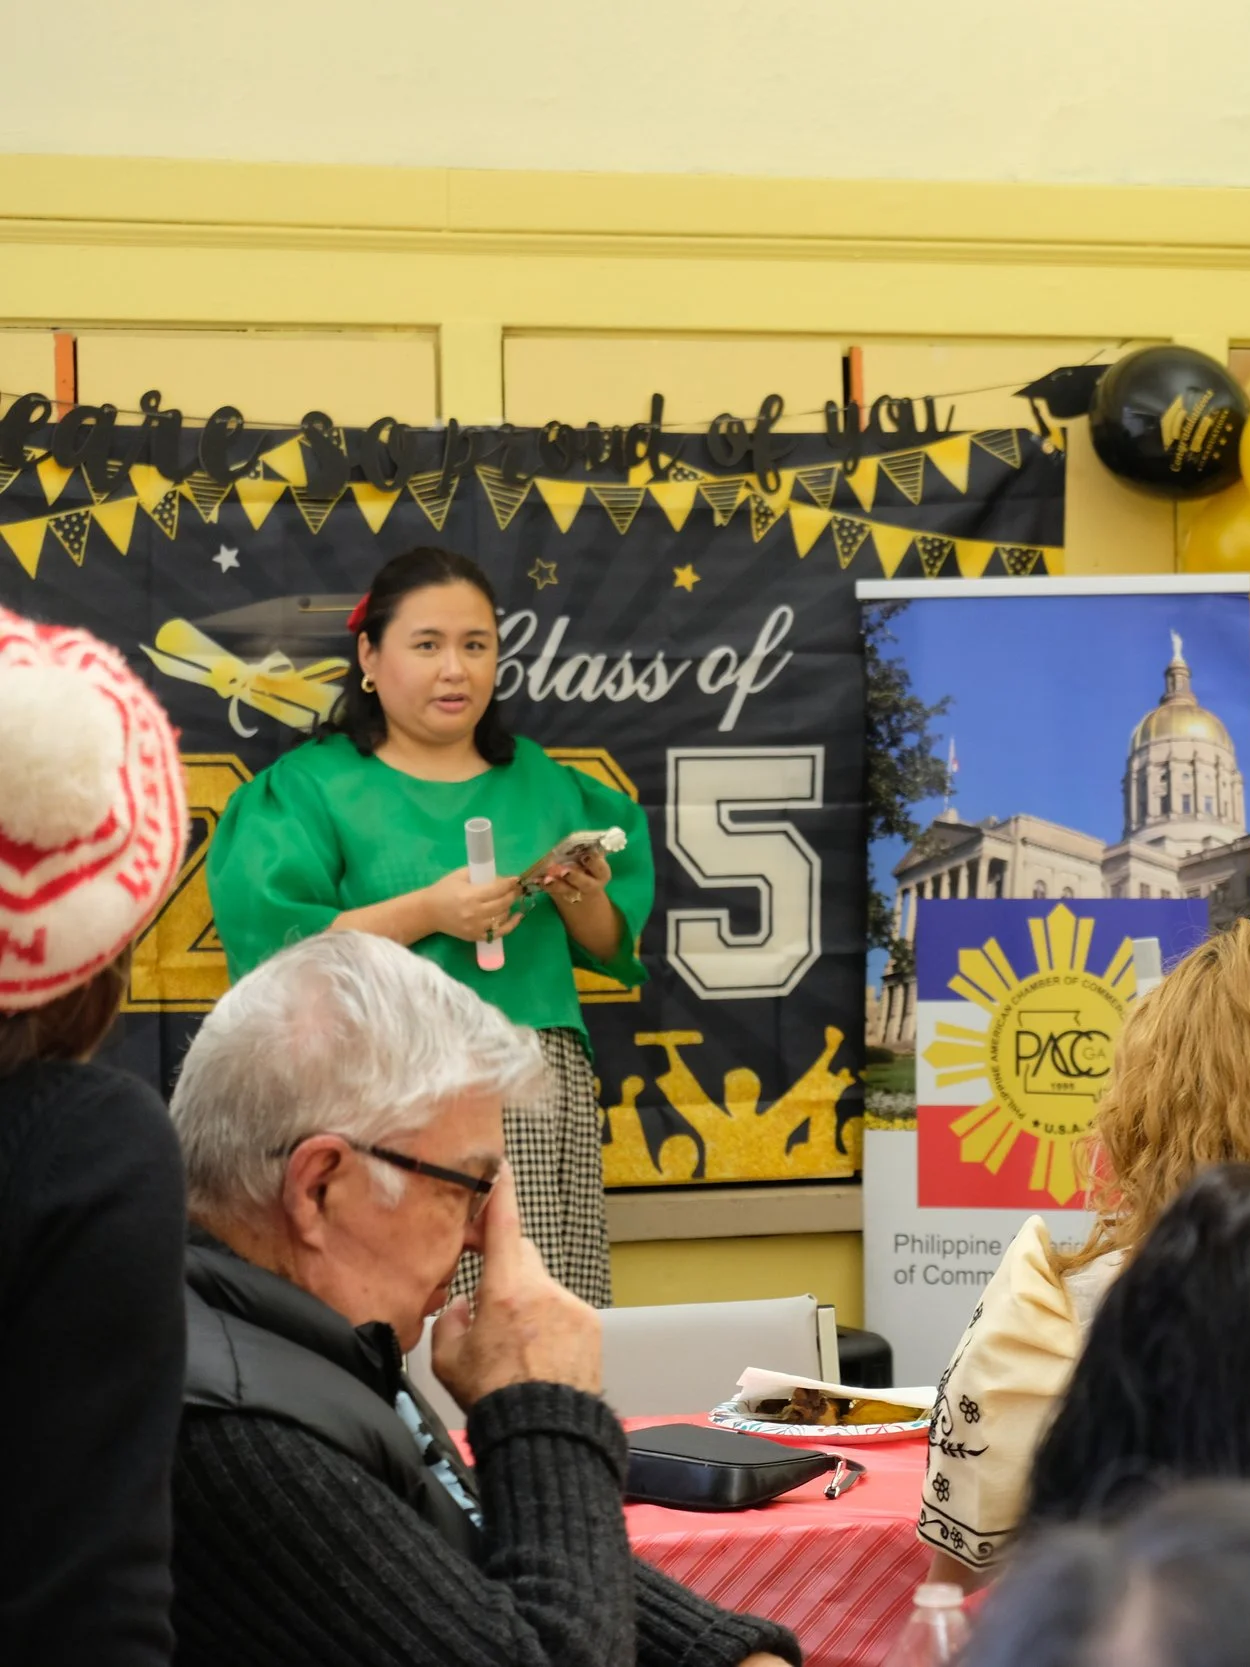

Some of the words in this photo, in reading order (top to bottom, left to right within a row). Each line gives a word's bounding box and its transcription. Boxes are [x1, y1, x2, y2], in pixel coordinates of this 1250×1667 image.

[299, 410, 408, 500] so
[436, 393, 688, 498] proud
[706, 393, 800, 495] of
[823, 393, 956, 477] you
[697, 605, 794, 733] of
[1010, 976, 1061, 1005] CHAMBER
[1063, 976, 1079, 986] OF
[1081, 979, 1125, 1022] COMMER
[990, 1003, 1013, 1063] AMERICAN
[1015, 1030, 1111, 1079] PACC
[990, 1065, 1027, 1121] PHILIPPINE
[893, 1233, 1003, 1260] Philippine
[893, 1264, 917, 1285] of
[923, 1264, 996, 1286] Comm
